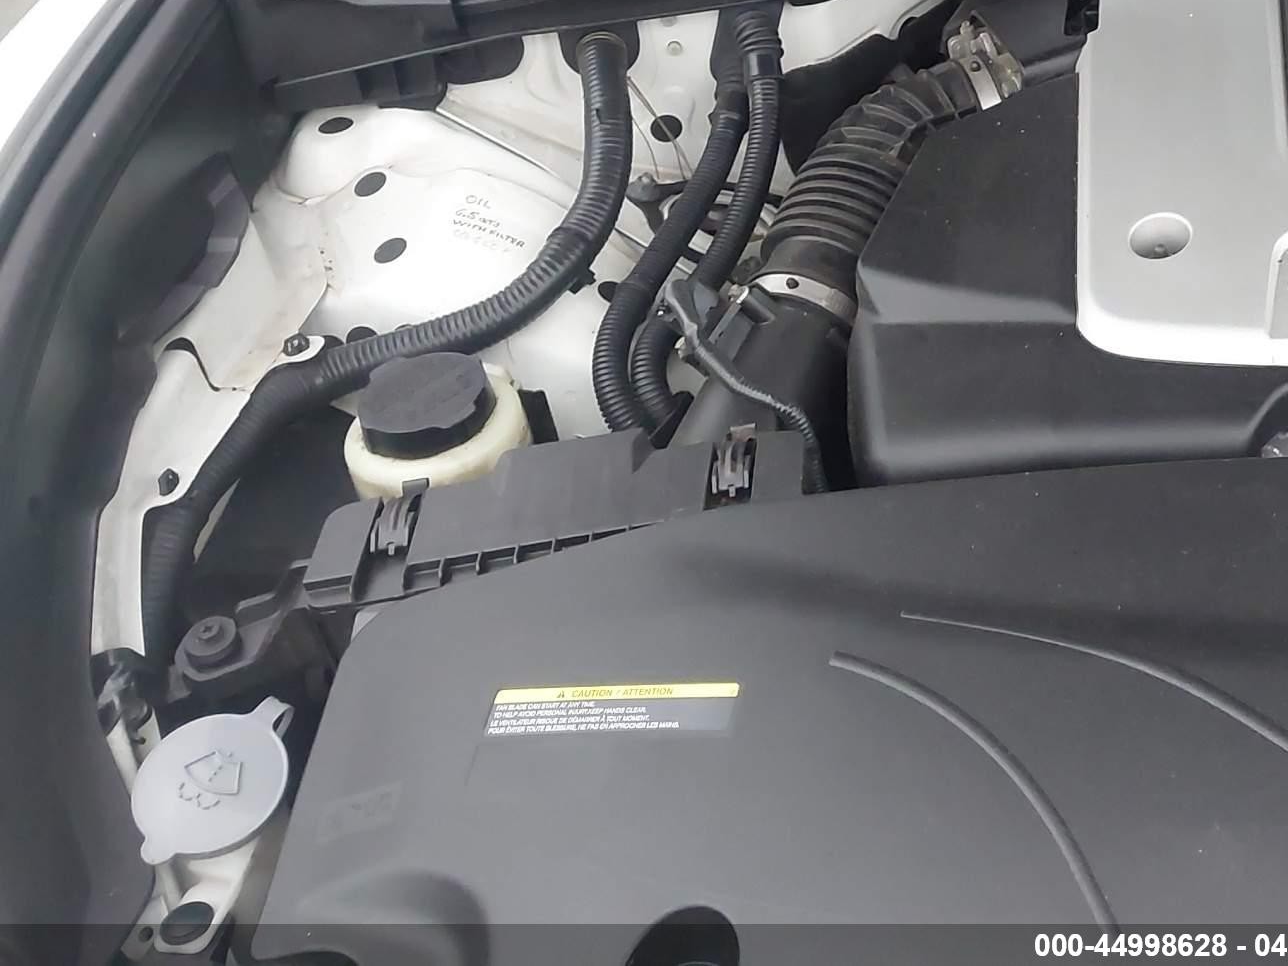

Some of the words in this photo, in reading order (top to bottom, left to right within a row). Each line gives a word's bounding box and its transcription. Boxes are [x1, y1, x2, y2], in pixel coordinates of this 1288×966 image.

[465, 195, 491, 209] OIL
[453, 219, 487, 232] WITH
[489, 229, 526, 248] FILTER
[571, 689, 613, 698] CAUTION
[622, 687, 673, 696] ATTENTION
